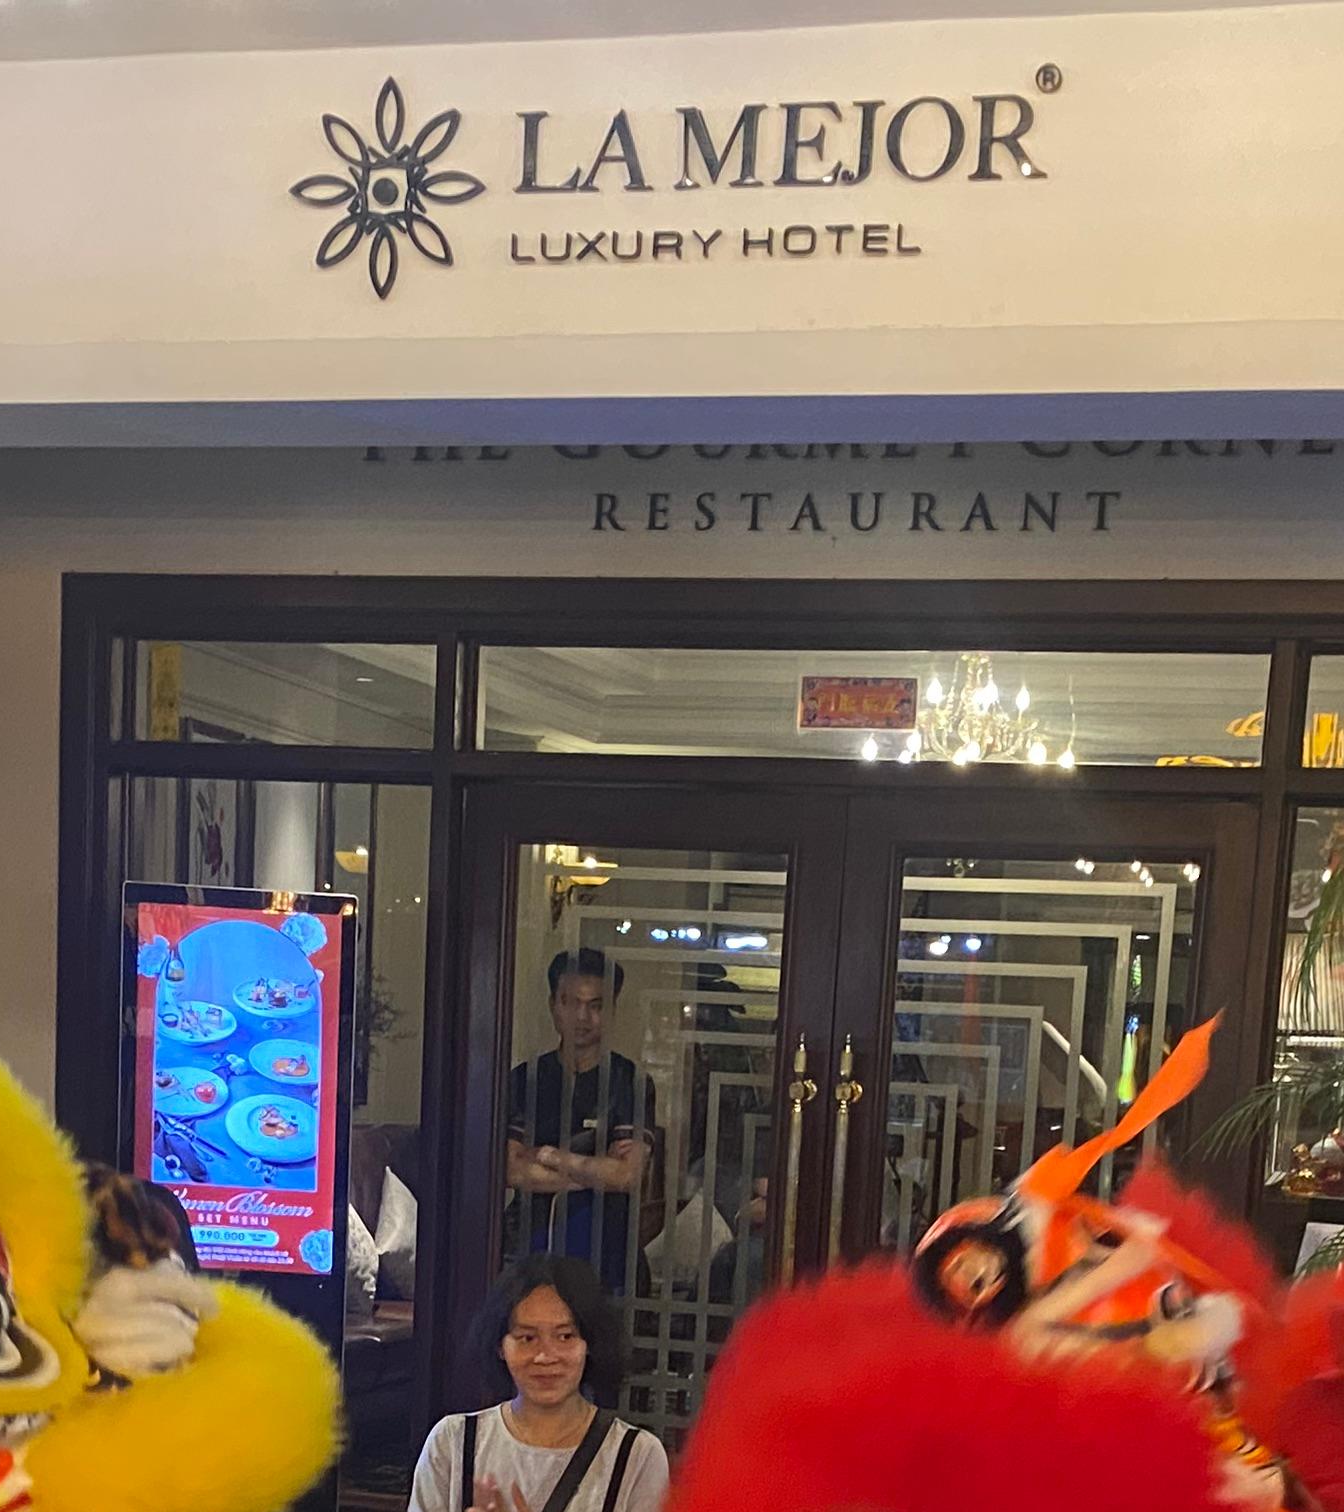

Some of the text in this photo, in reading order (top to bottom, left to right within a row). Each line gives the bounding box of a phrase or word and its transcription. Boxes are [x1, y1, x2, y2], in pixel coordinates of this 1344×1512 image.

[513, 108, 654, 193] LA
[510, 223, 922, 264] LUXURY HOTEL
[592, 491, 1122, 533] RESTAURANT
[197, 1213, 269, 1226] SET MENU
